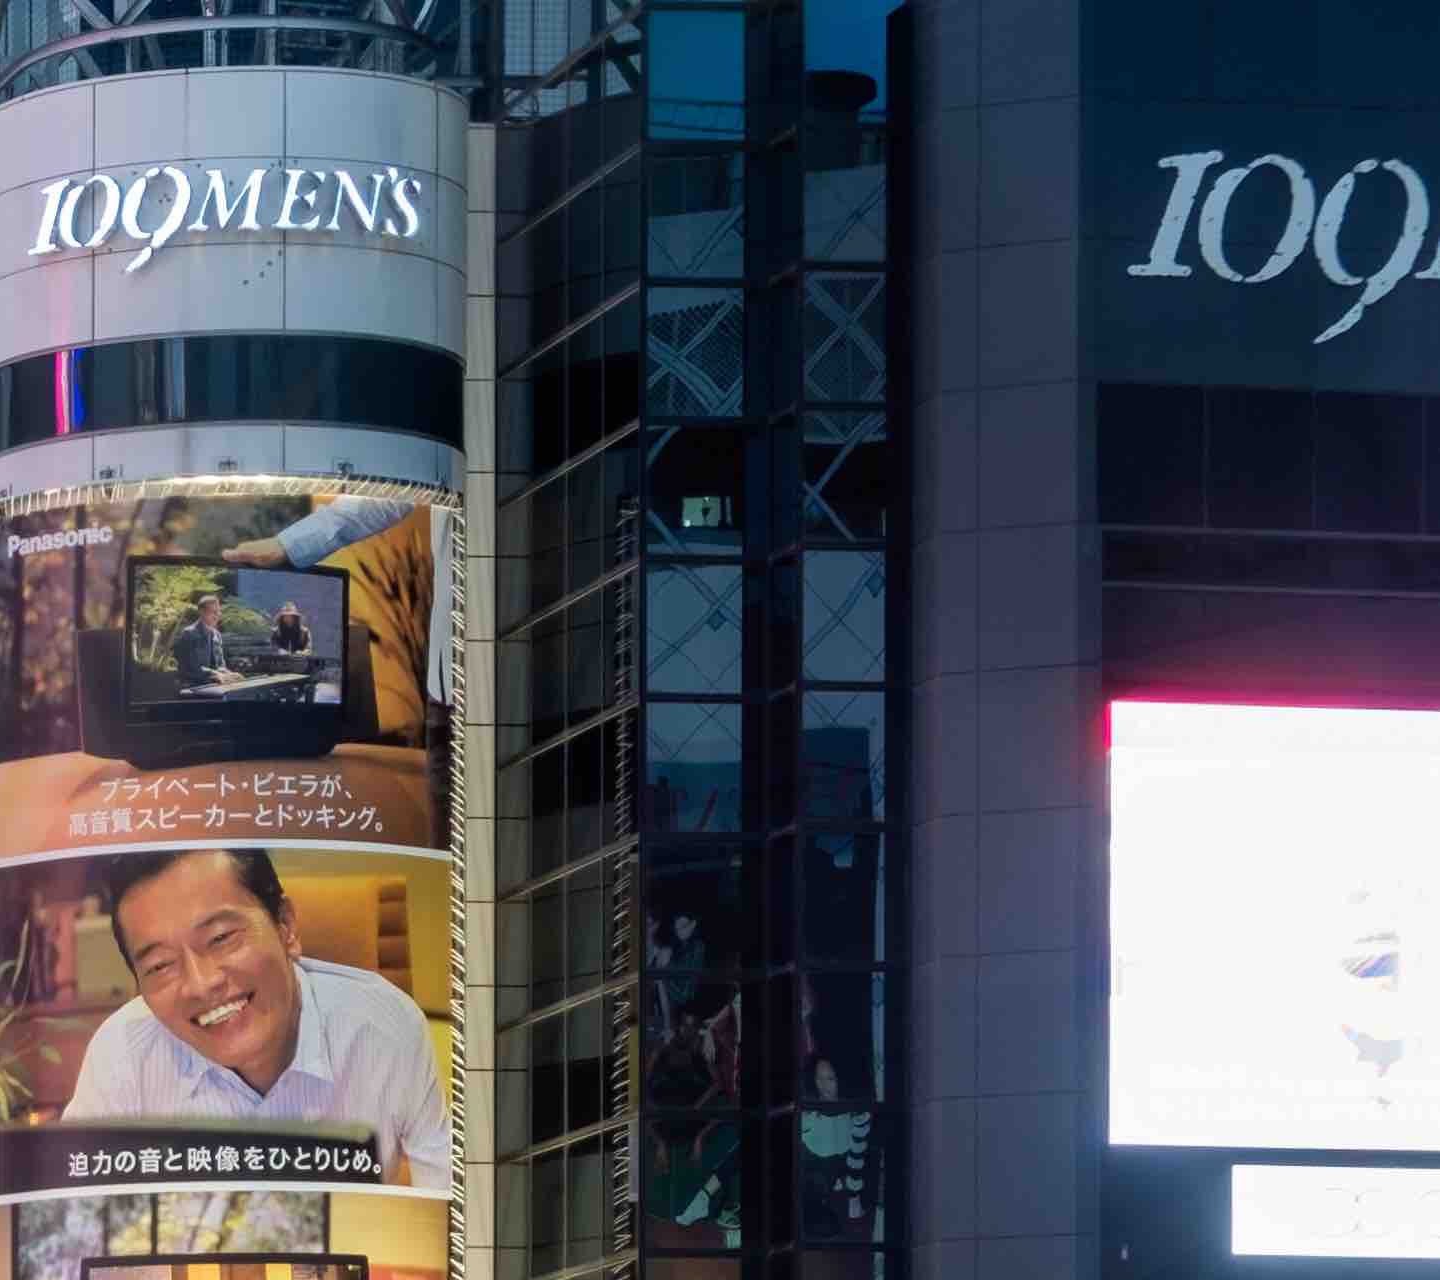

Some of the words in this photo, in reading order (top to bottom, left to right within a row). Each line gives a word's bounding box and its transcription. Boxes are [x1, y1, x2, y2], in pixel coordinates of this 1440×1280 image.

[1126, 148, 1440, 345] 109
[6, 523, 114, 557] Panasonic
[68, 804, 386, 837] 高音質スピーカーとドッキング。
[68, 1143, 385, 1179] 迫力の音と映像をひとりじめ。
